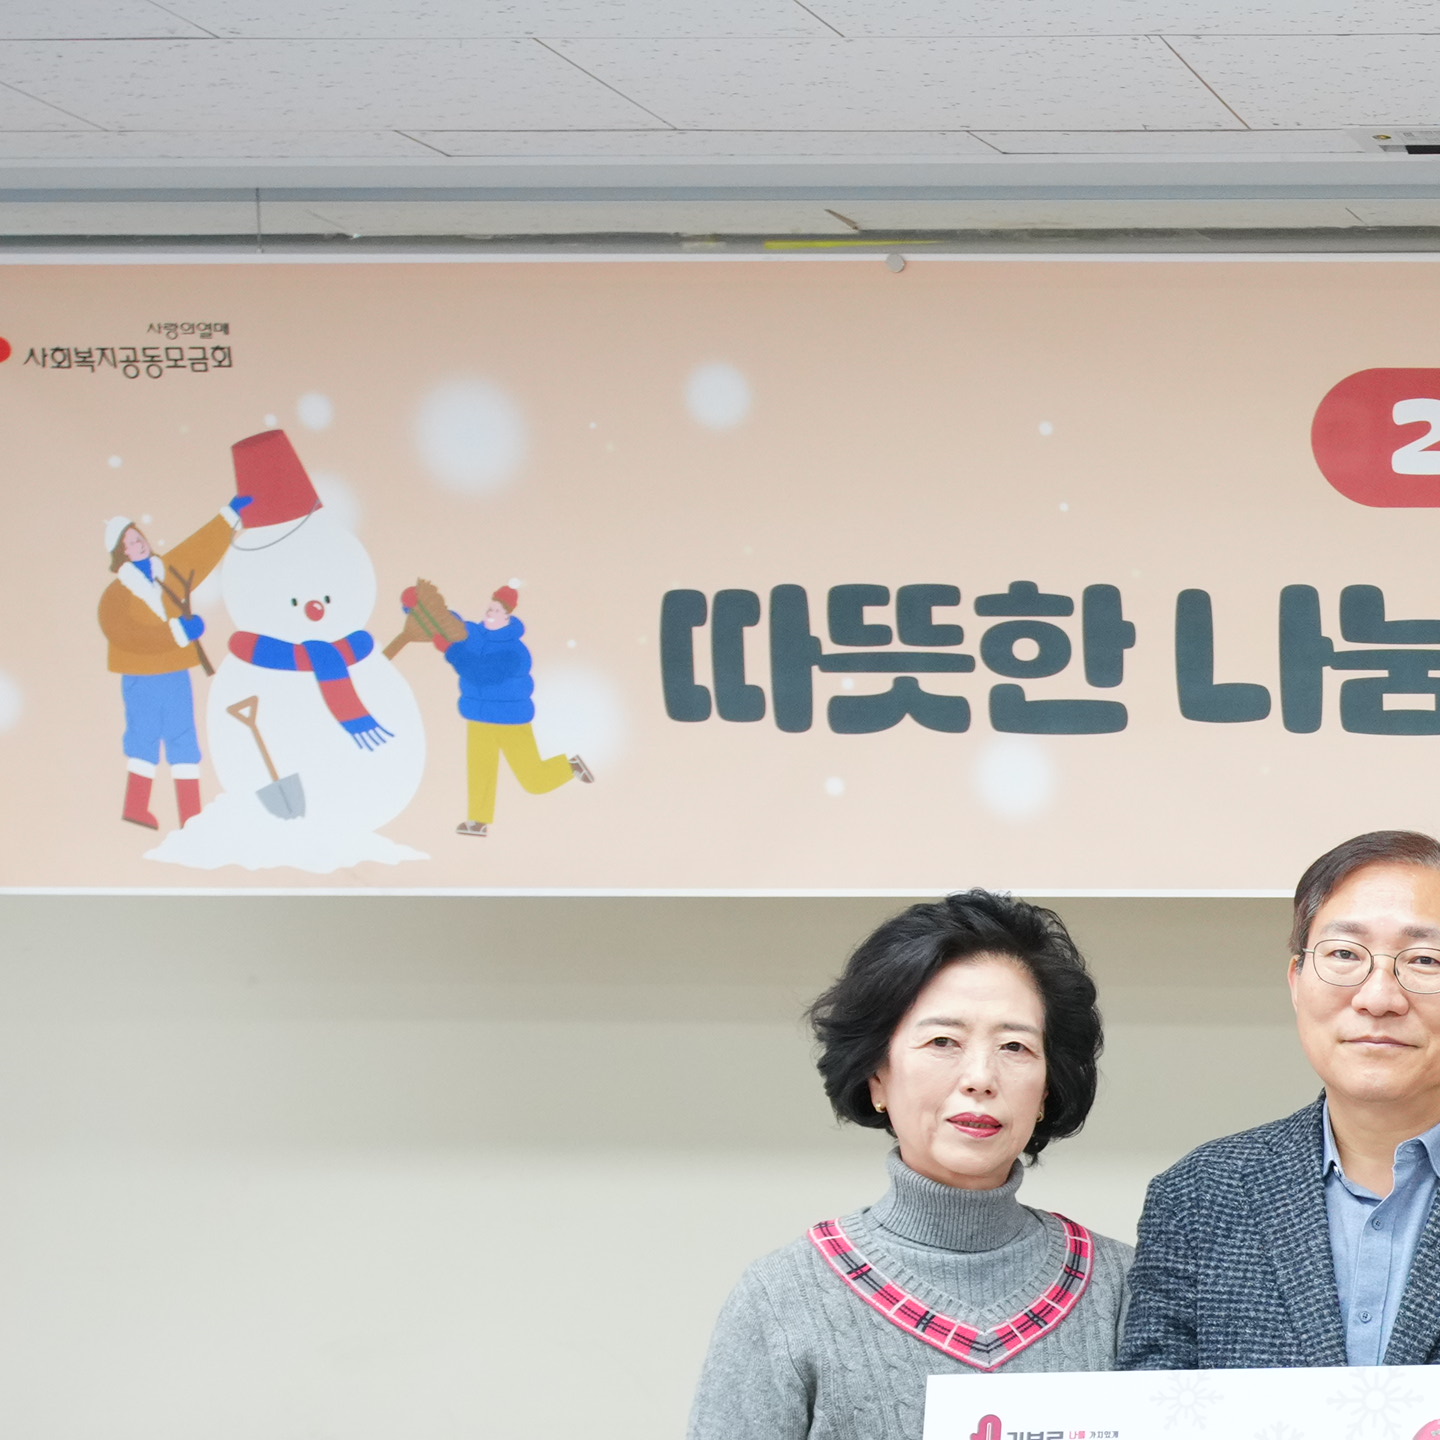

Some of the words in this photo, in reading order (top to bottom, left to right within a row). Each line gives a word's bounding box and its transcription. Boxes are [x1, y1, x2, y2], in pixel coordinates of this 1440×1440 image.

[148, 323, 229, 340] 사랑의열매
[24, 345, 232, 379] 사회복지공동모금회
[660, 581, 1136, 735] 따뜻한
